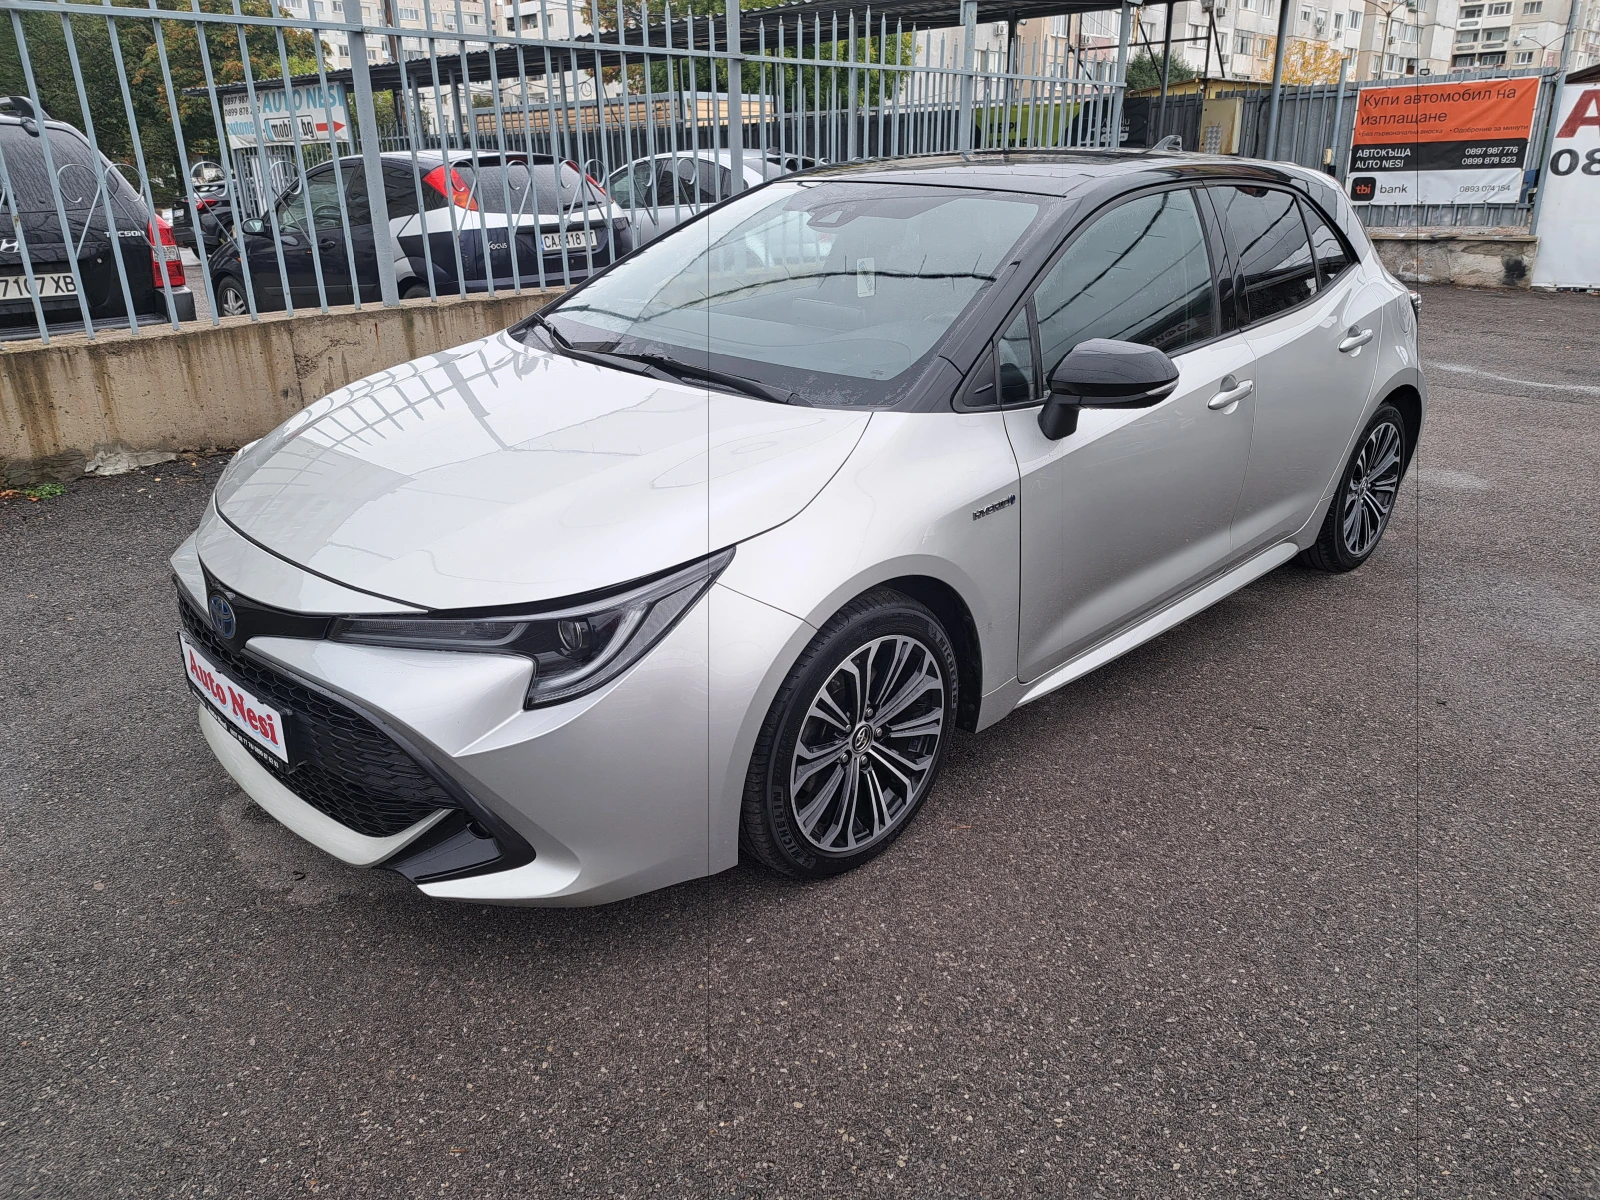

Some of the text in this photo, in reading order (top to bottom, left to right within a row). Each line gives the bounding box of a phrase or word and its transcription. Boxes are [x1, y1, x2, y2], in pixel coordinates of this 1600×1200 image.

[263, 90, 302, 113] AUTO
[306, 85, 343, 109] NESI
[1363, 88, 1516, 110] Купи автомобил на
[224, 107, 238, 117] 0899
[1361, 111, 1448, 125] изплащане
[1453, 126, 1493, 134] Одобрение
[1356, 148, 1411, 158] АВТОКЪЩА
[1465, 146, 1519, 156] 0897 987 776
[1355, 159, 1404, 169] AUTO NESI
[1461, 155, 1517, 165] 0899 878 923
[1355, 184, 1409, 195] tbi bank
[1459, 185, 1480, 193] 0893
[543, 233, 558, 248] CA
[50, 275, 77, 294] XB
[189, 649, 279, 746] Auto Nesi
[772, 790, 804, 861] MICHELIN
